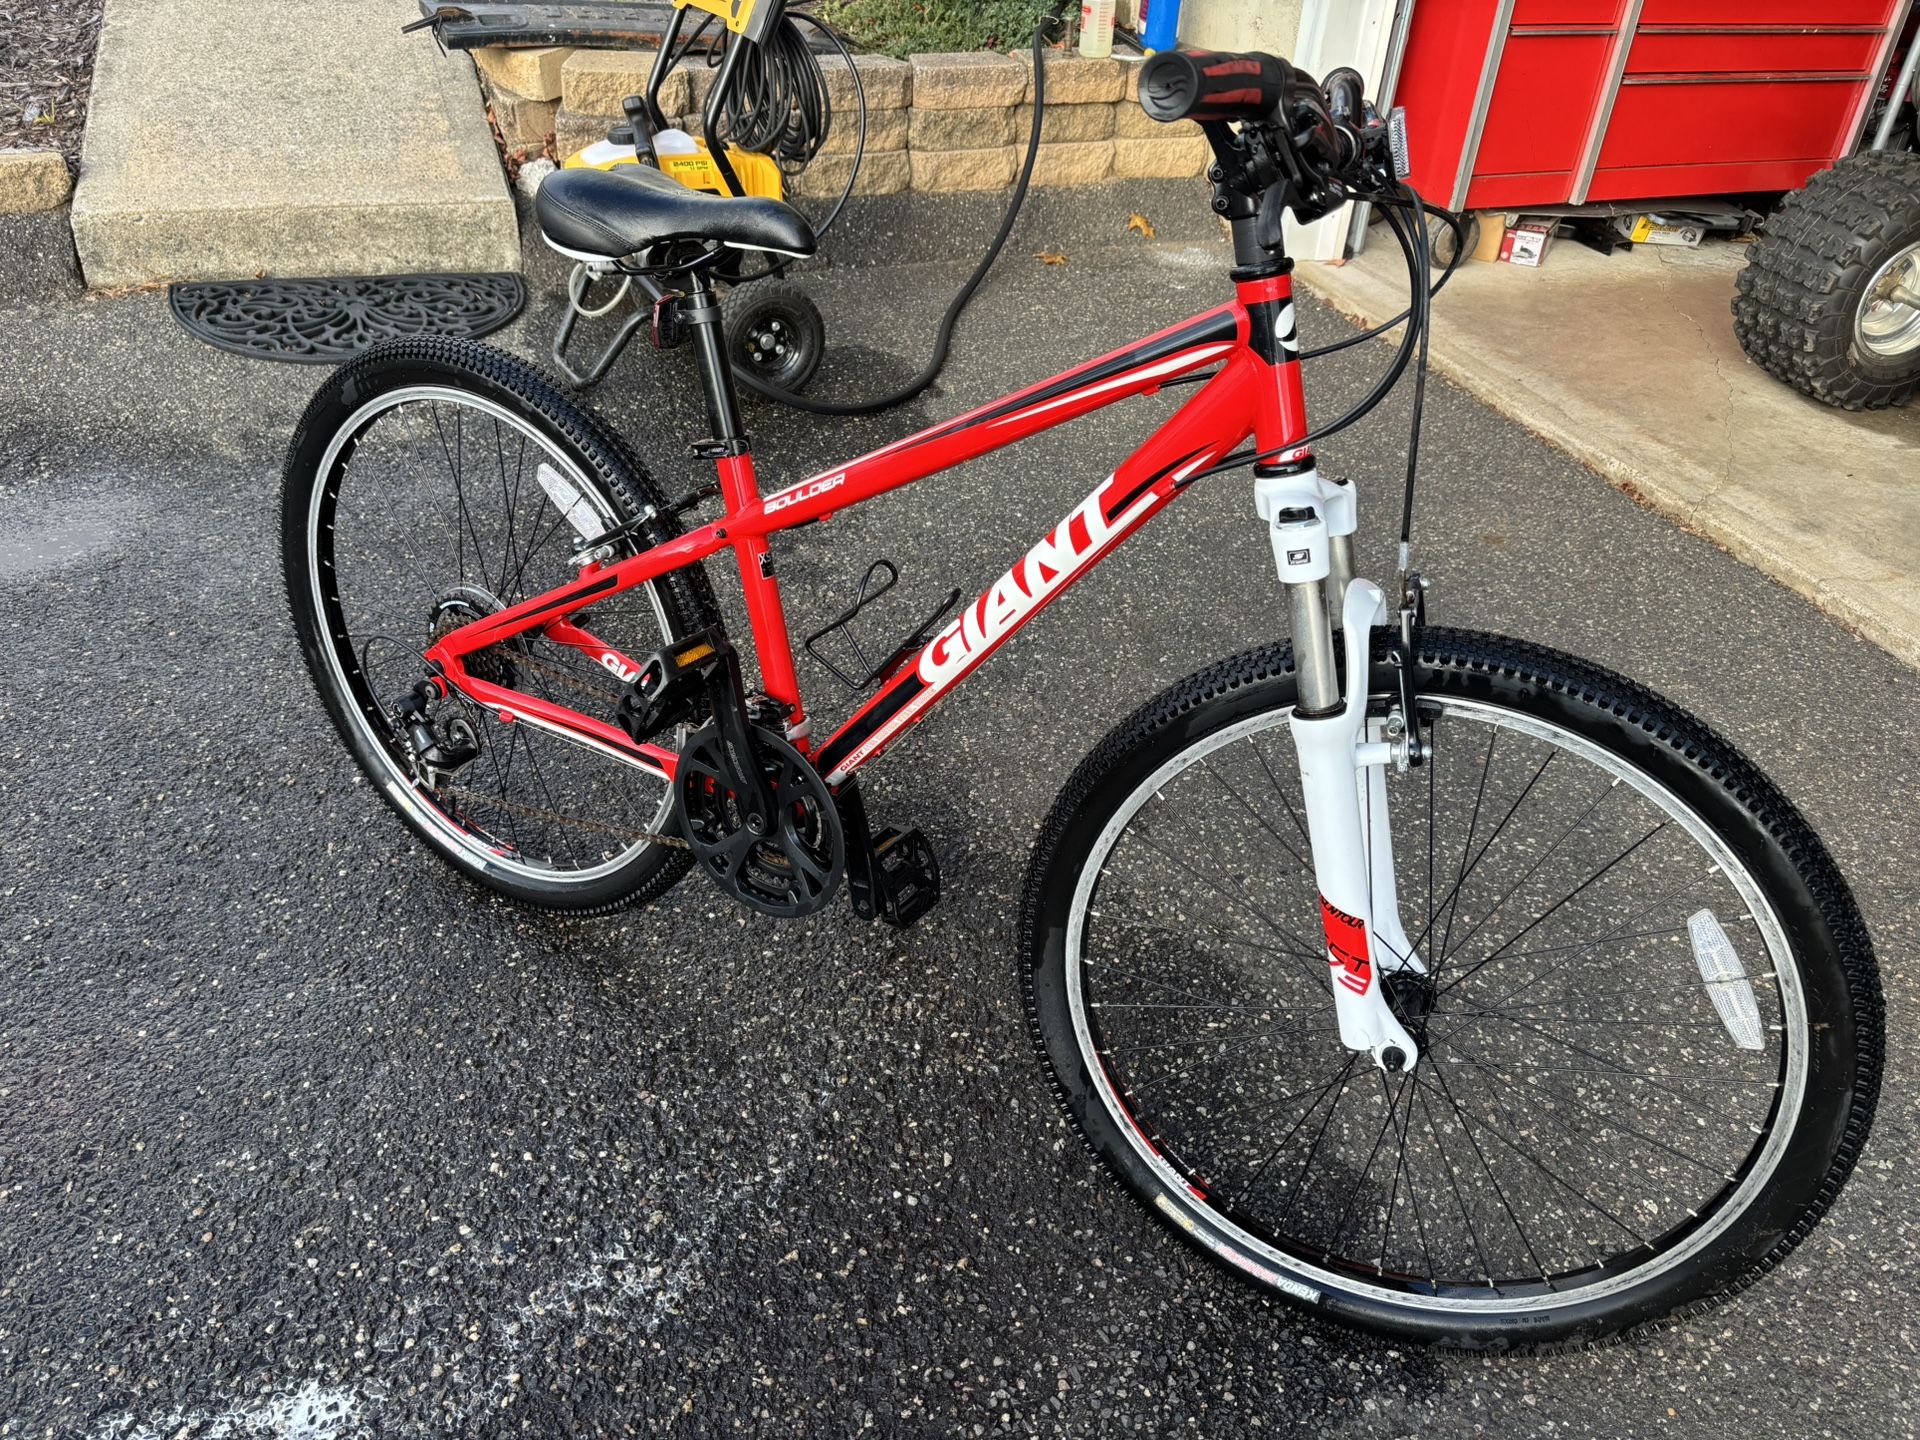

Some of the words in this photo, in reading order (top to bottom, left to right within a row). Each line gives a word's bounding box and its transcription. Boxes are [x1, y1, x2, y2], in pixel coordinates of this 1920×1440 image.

[763, 472, 846, 516] BOULDER
[758, 551, 773, 565] XS
[918, 472, 1115, 683] GIANT
[839, 748, 866, 773] GIANT
[1324, 933, 1370, 973] CT
[1276, 1276, 1320, 1302] KENDA
